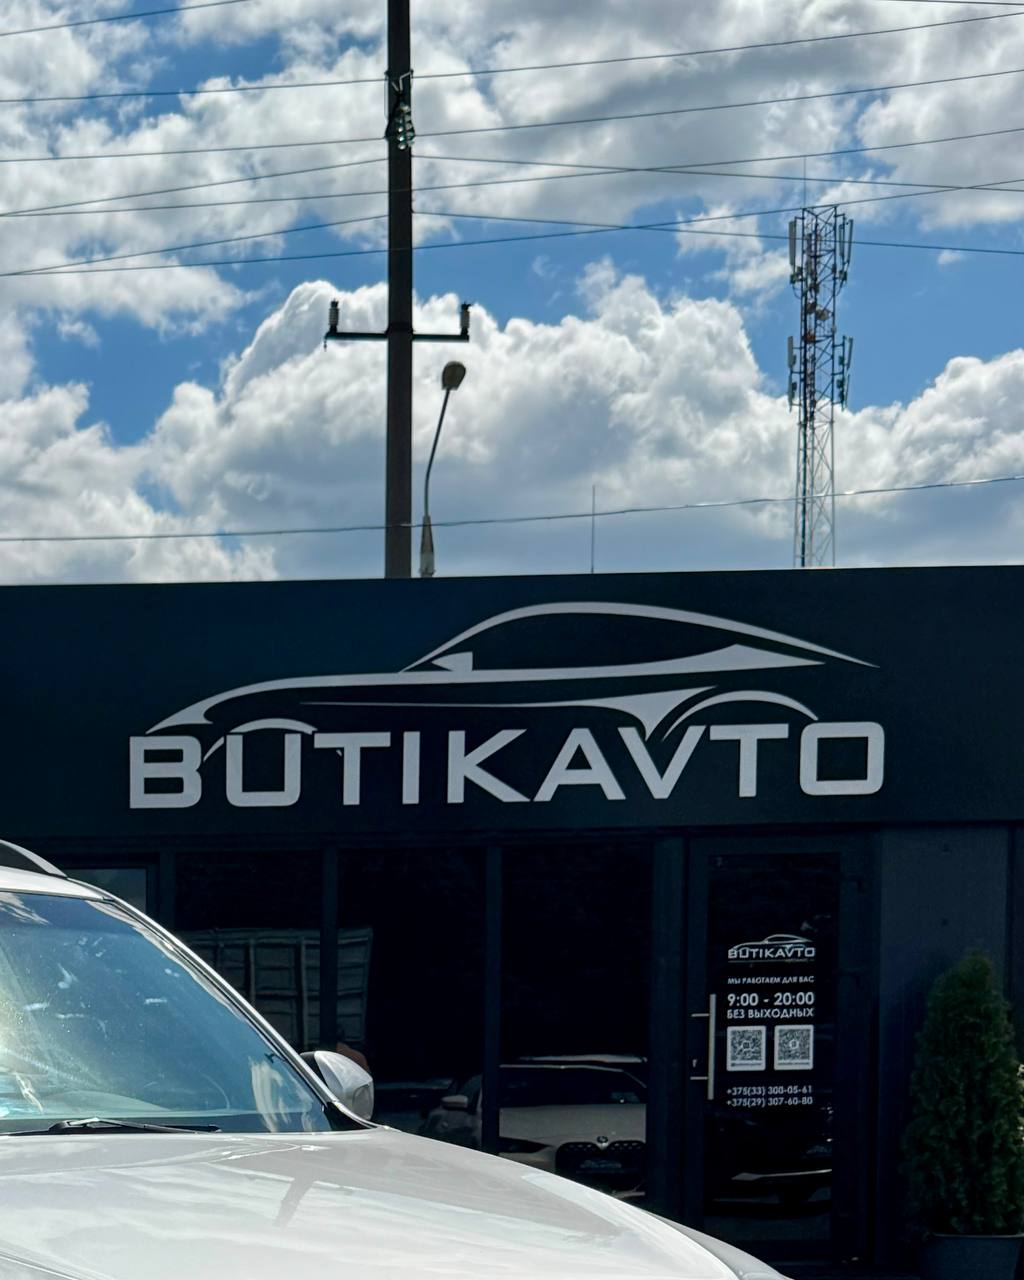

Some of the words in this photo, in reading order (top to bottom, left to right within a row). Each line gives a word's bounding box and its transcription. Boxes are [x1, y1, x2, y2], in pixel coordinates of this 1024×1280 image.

[129, 721, 885, 808] BUTIKAVTO
[728, 947, 815, 958] BUTIKAVTO
[742, 976, 781, 985] РАБОТАЕМ
[798, 975, 815, 983] ВАС
[727, 992, 759, 1007] 9:00
[773, 991, 815, 1006] 20:00
[726, 1008, 745, 1019] БЕЗ
[748, 1007, 815, 1018] ВЫХОДНЫХ
